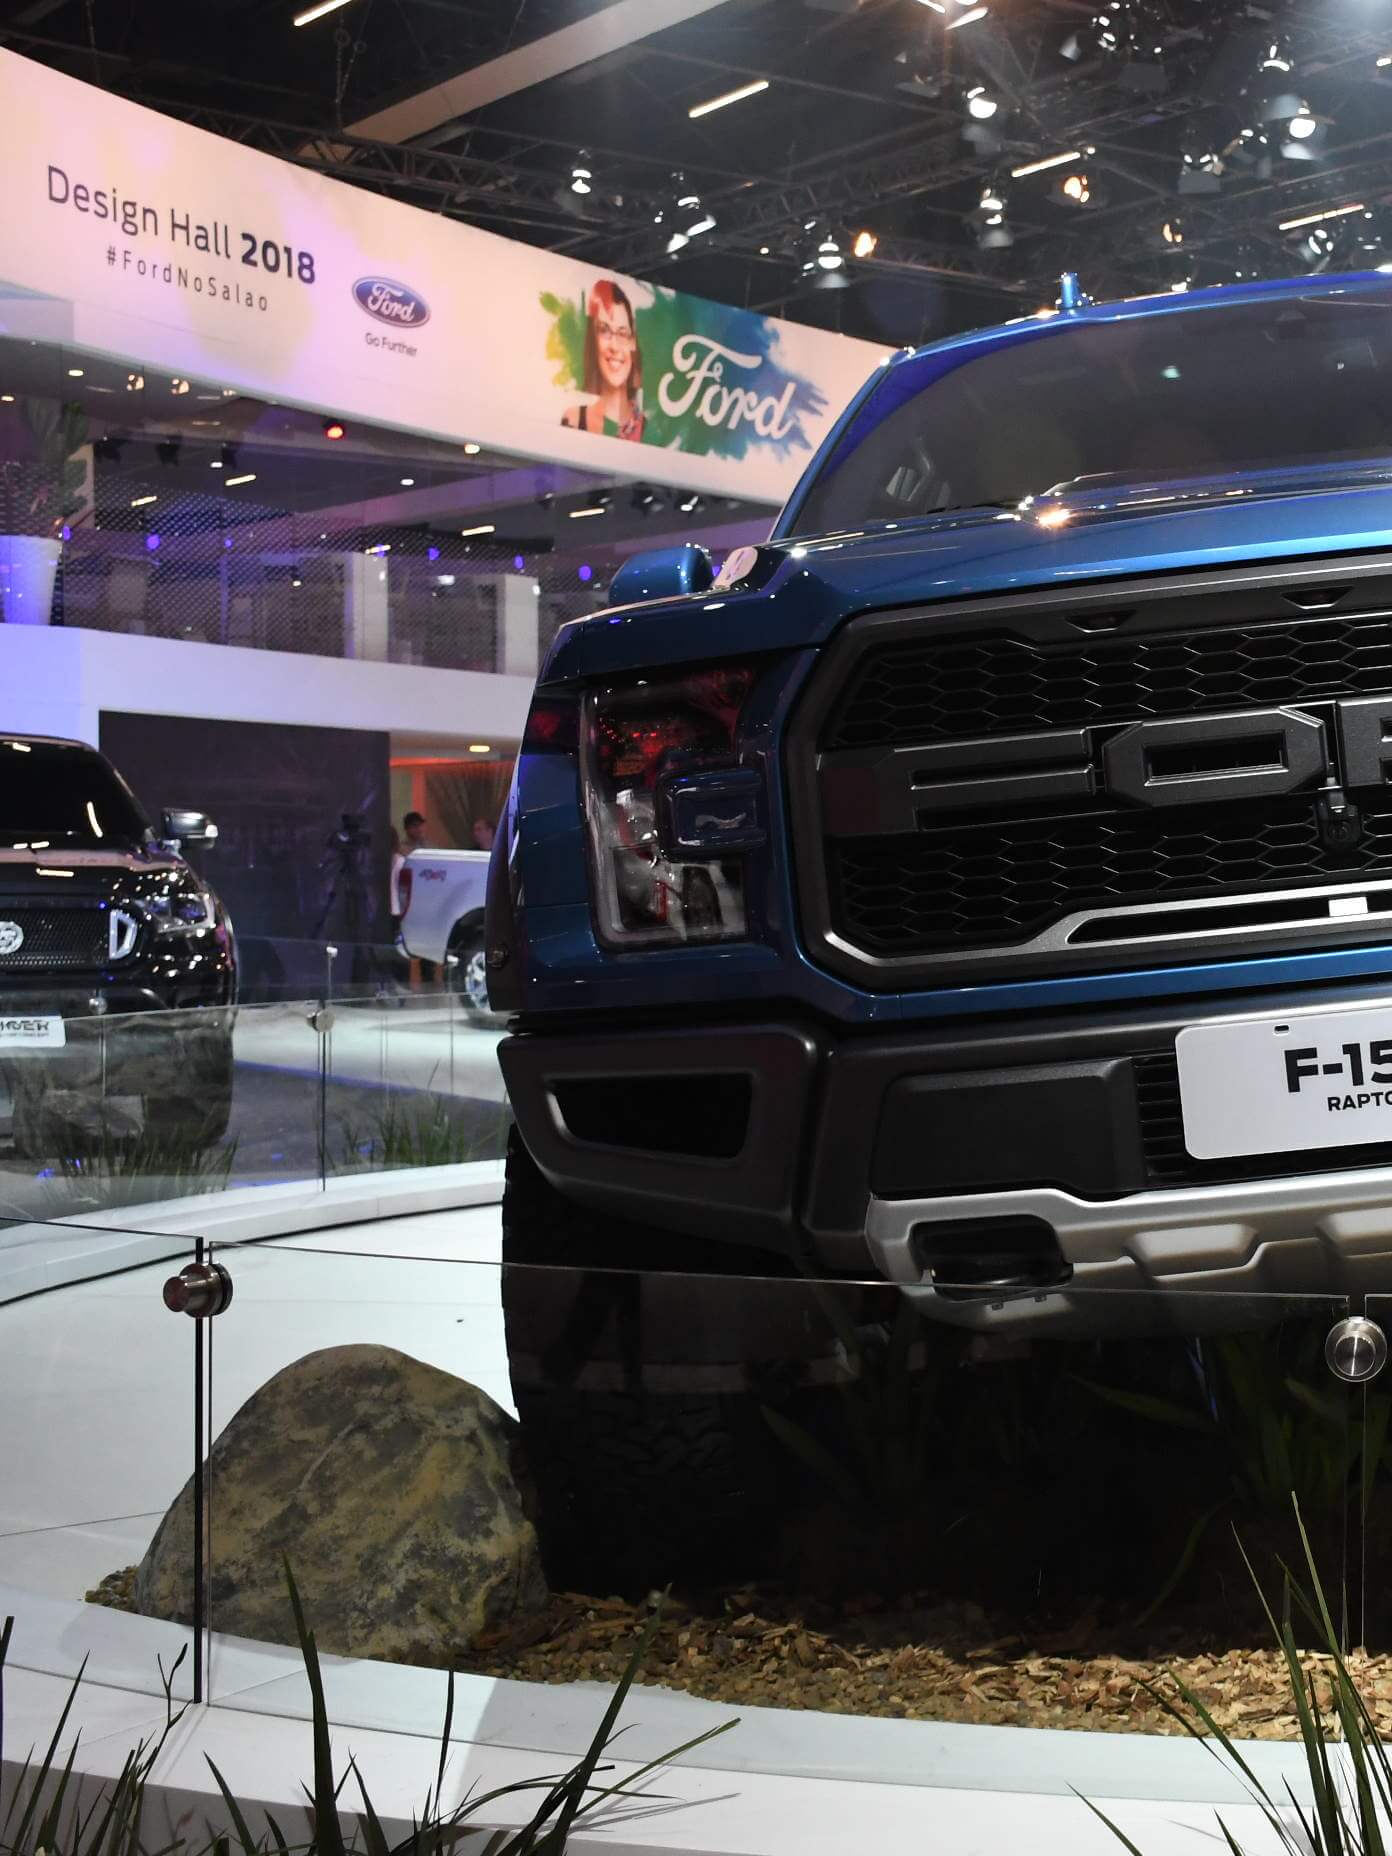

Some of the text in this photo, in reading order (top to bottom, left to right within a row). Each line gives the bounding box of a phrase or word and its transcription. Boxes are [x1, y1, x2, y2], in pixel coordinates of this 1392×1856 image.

[48, 165, 315, 285] Design Hall 2018
[107, 245, 269, 312] #FordNoSalao
[365, 332, 418, 357] Go Further
[658, 334, 797, 440] Ford
